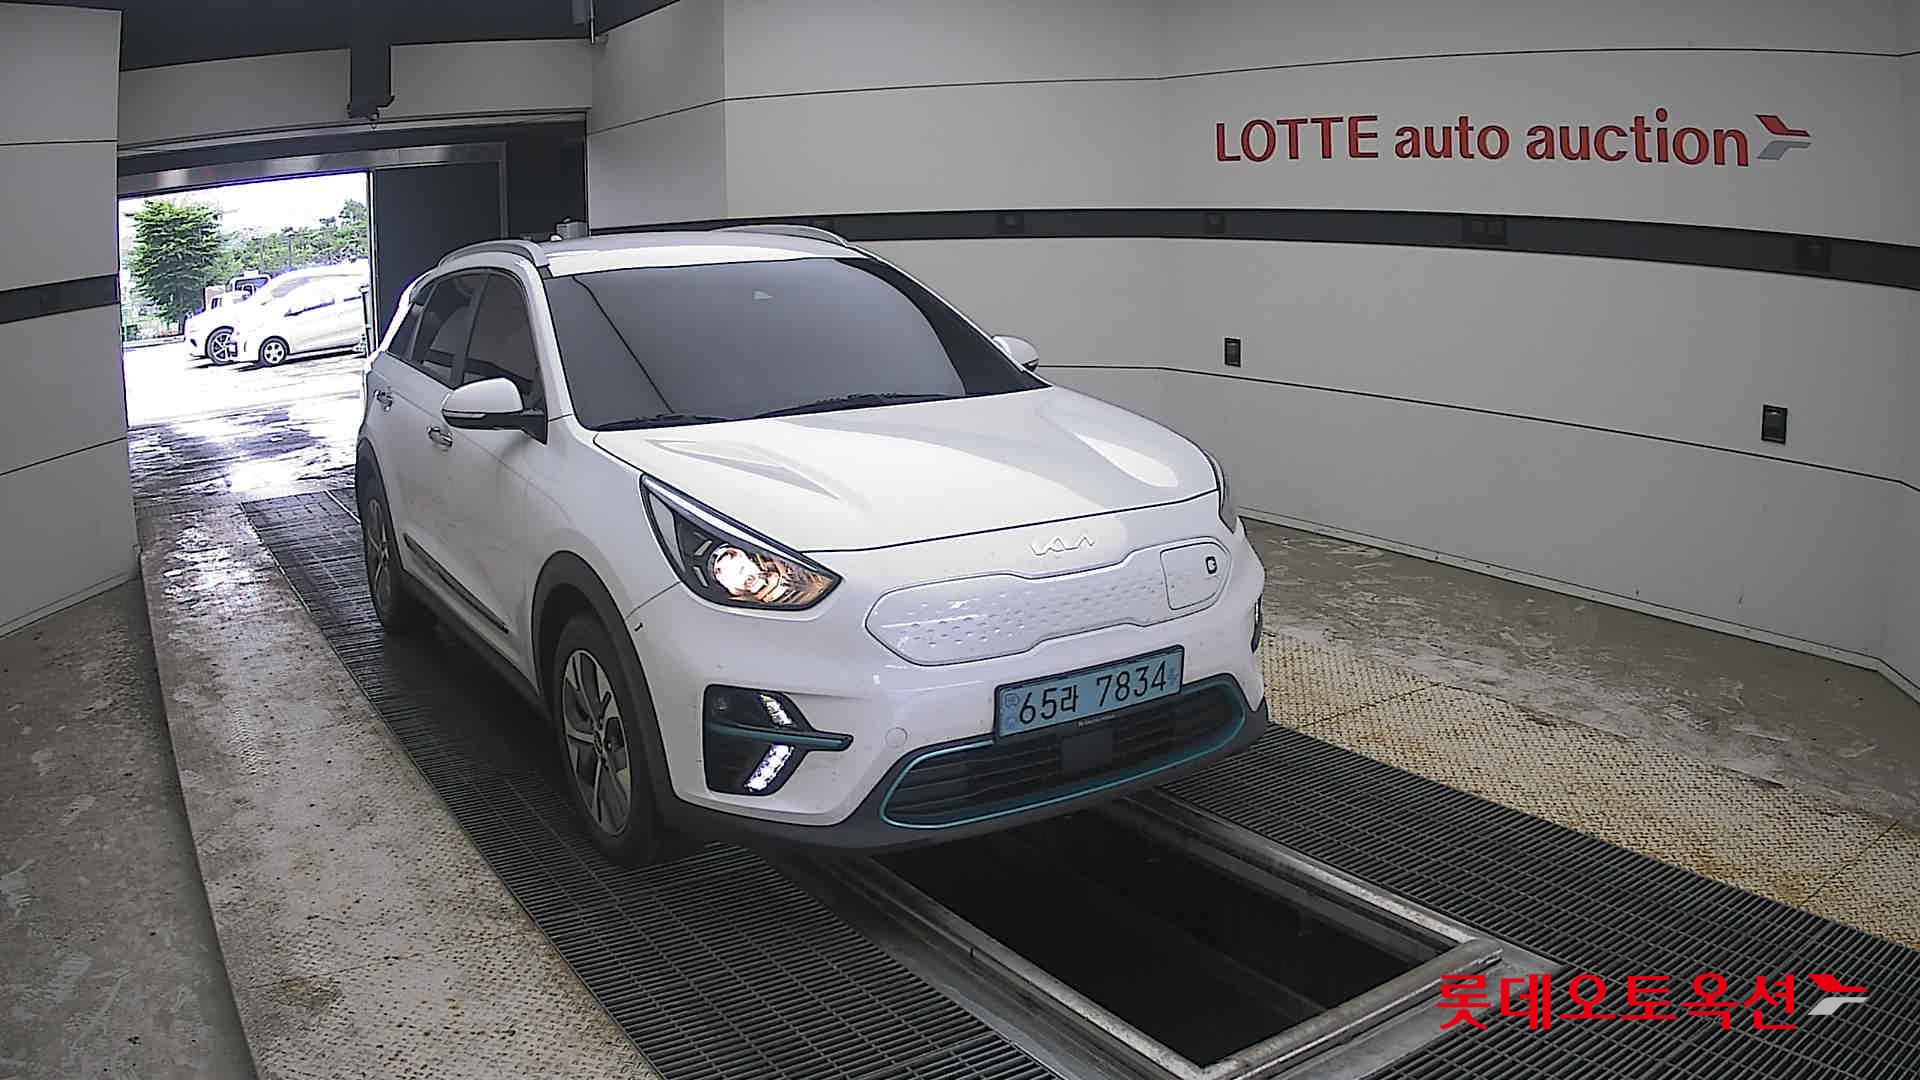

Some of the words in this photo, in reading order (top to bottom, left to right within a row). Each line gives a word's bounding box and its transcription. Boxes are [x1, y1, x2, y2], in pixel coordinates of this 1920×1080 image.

[1215, 114, 1380, 162] LOTTE
[1394, 115, 1511, 161] auto
[1525, 108, 1750, 167] auction
[1019, 684, 1079, 724] 65라
[1096, 660, 1167, 708] 7834
